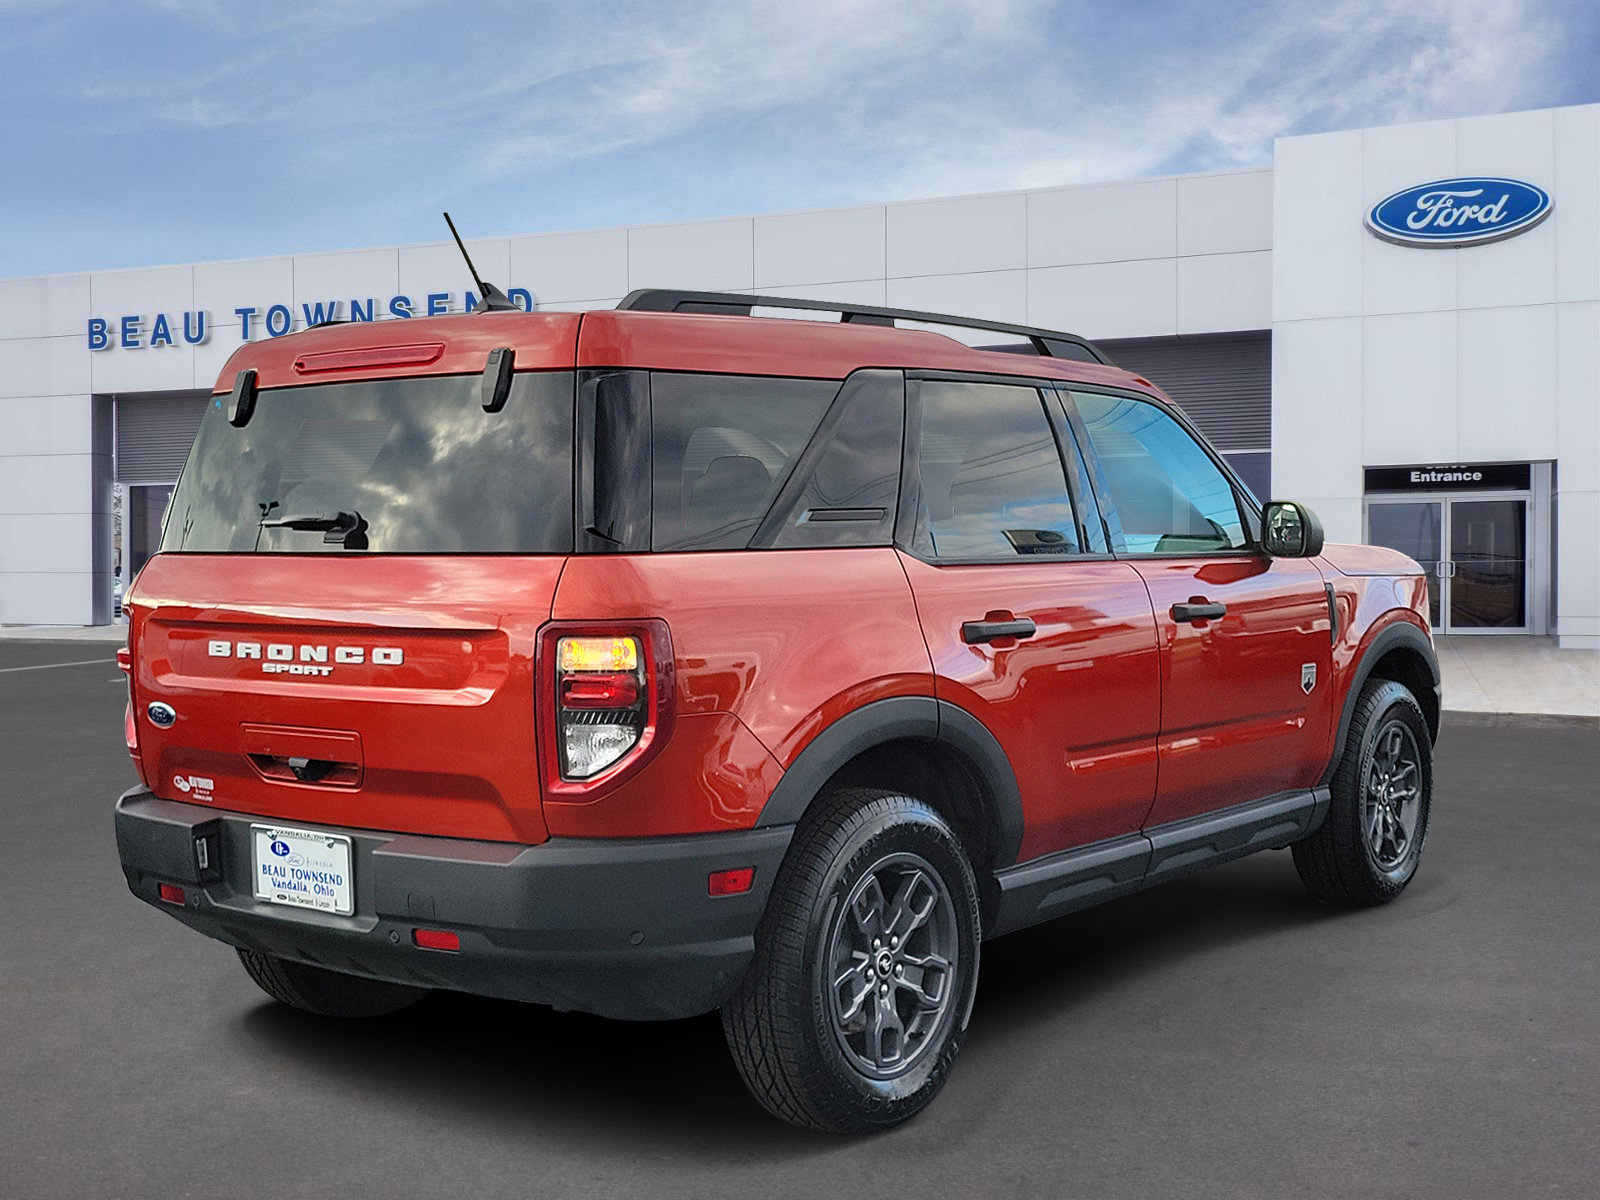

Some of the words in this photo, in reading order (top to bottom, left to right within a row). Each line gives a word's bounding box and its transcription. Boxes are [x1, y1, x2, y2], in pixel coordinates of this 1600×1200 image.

[1406, 188, 1510, 230] Ford
[88, 311, 204, 349] BEAU
[1410, 471, 1482, 483] Entrance
[208, 640, 404, 665] BRONCO
[262, 663, 334, 676] SPORT
[262, 864, 286, 878] BEAU
[290, 868, 343, 886] TOWNSEND
